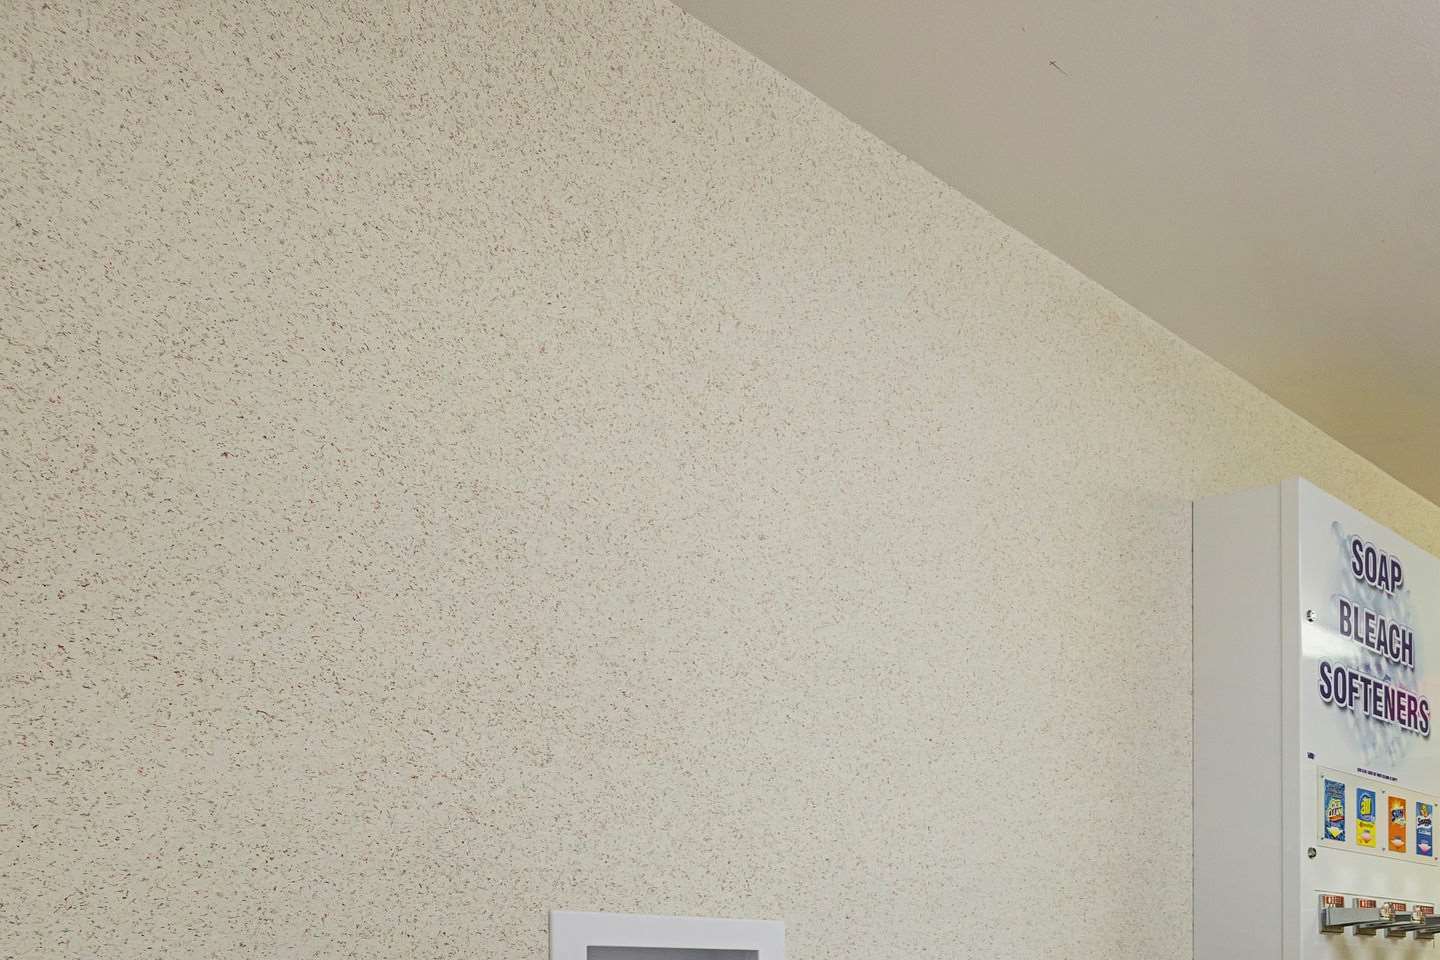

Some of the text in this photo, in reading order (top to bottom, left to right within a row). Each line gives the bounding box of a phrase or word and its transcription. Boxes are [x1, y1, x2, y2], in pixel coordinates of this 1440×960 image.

[1352, 538, 1402, 592] SOAP
[1339, 599, 1414, 666] BLEACH
[1319, 660, 1429, 735] SOFTENERS
